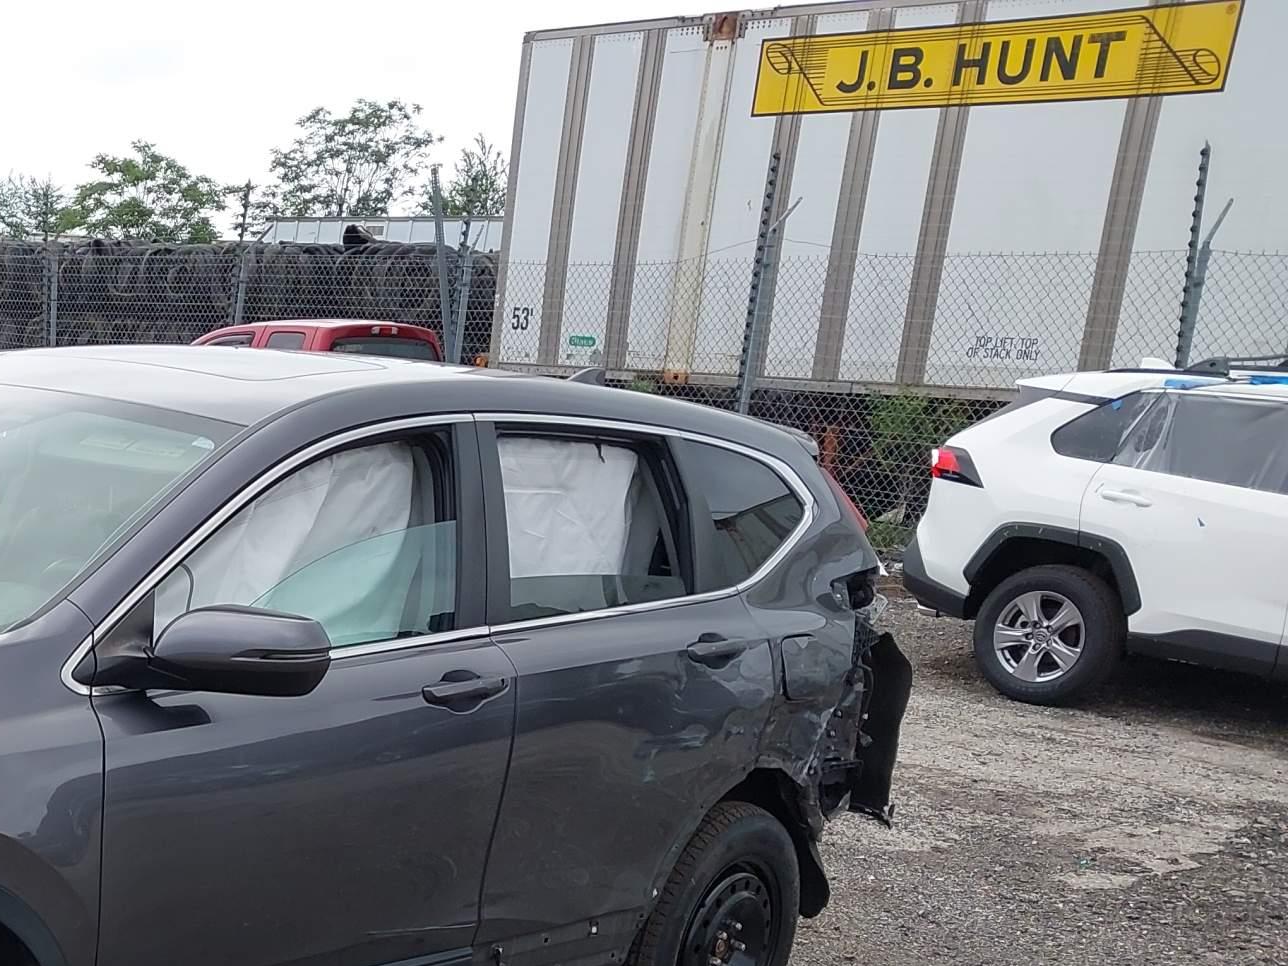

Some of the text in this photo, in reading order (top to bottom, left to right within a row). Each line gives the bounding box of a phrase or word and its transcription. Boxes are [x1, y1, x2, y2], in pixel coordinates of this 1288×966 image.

[836, 30, 1127, 94] J.B. HUNT
[975, 335, 993, 348] TOP
[1018, 338, 1039, 350] TOP
[966, 346, 1040, 361] OF STACK ONLY
